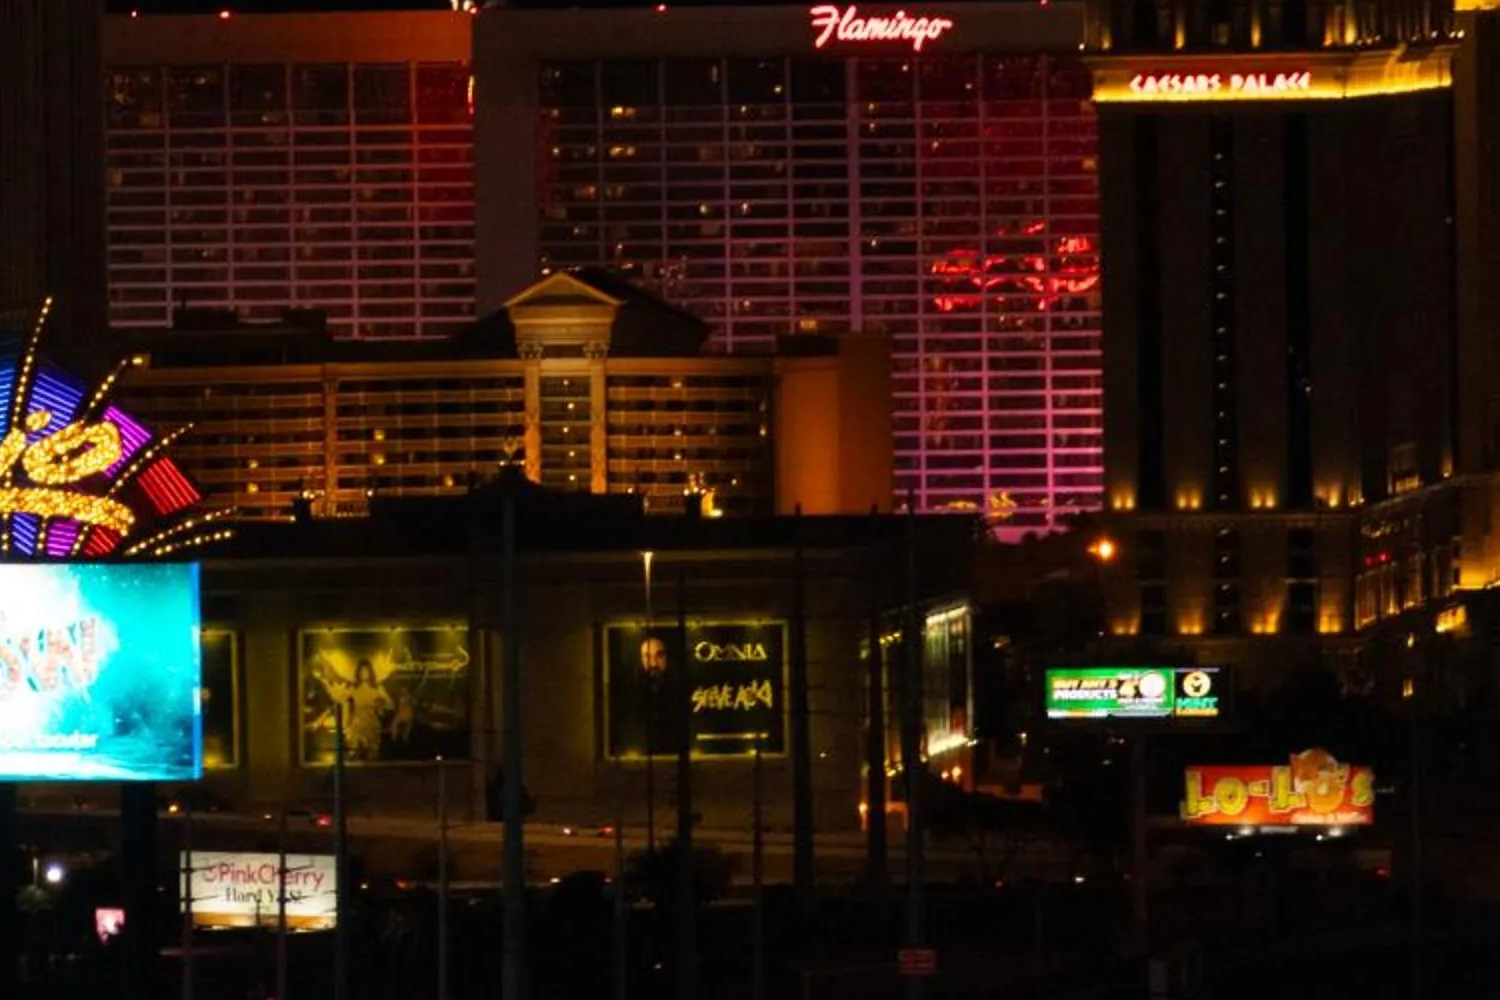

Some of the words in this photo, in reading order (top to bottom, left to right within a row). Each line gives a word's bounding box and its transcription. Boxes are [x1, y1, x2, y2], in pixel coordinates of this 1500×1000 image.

[810, 4, 953, 51] Flamingo
[1129, 74, 1222, 94] CAESARS
[1230, 72, 1312, 93] PALACE
[695, 641, 768, 661] OMNIA
[219, 862, 324, 888] PinkCherry
